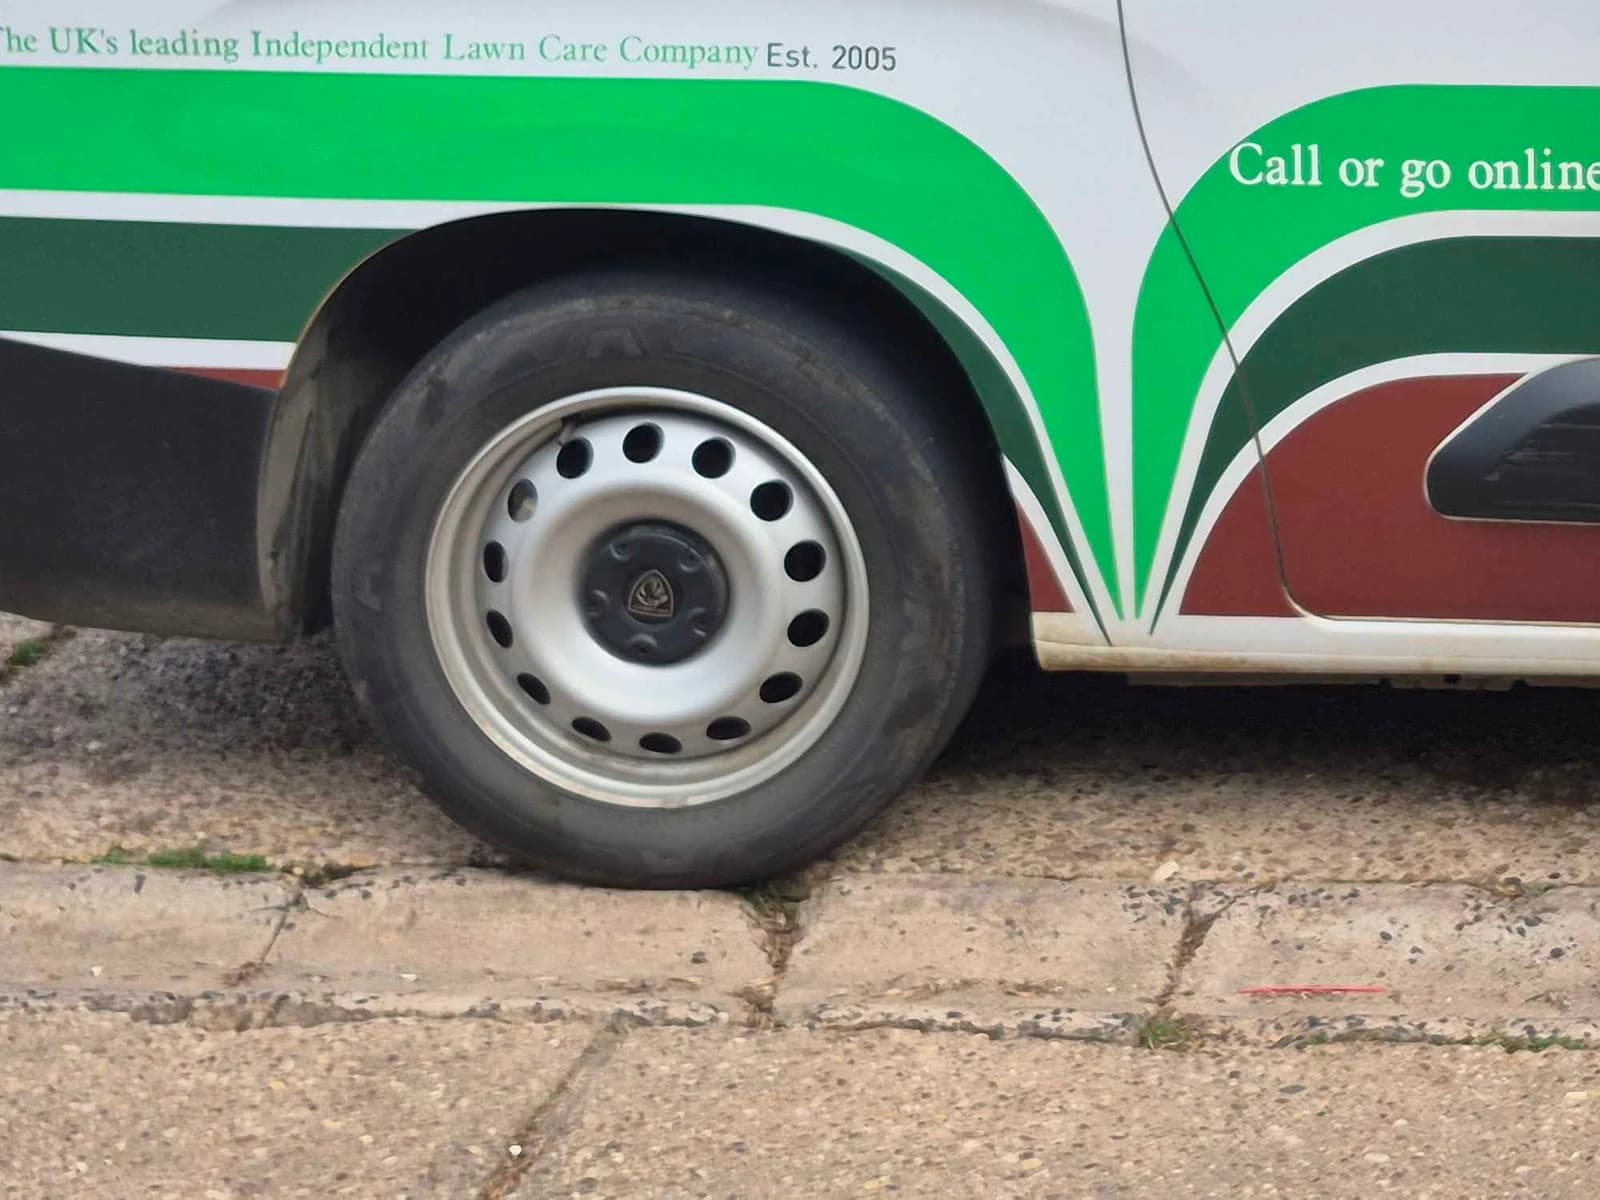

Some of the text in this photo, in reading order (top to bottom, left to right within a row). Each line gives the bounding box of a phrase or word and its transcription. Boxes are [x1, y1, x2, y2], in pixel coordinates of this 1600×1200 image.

[0, 25, 897, 71] he UK's leading Independent Lawn Care Company Est. 2005
[1229, 143, 1323, 186] Call
[1338, 157, 1385, 187] or
[1400, 159, 1451, 198] go
